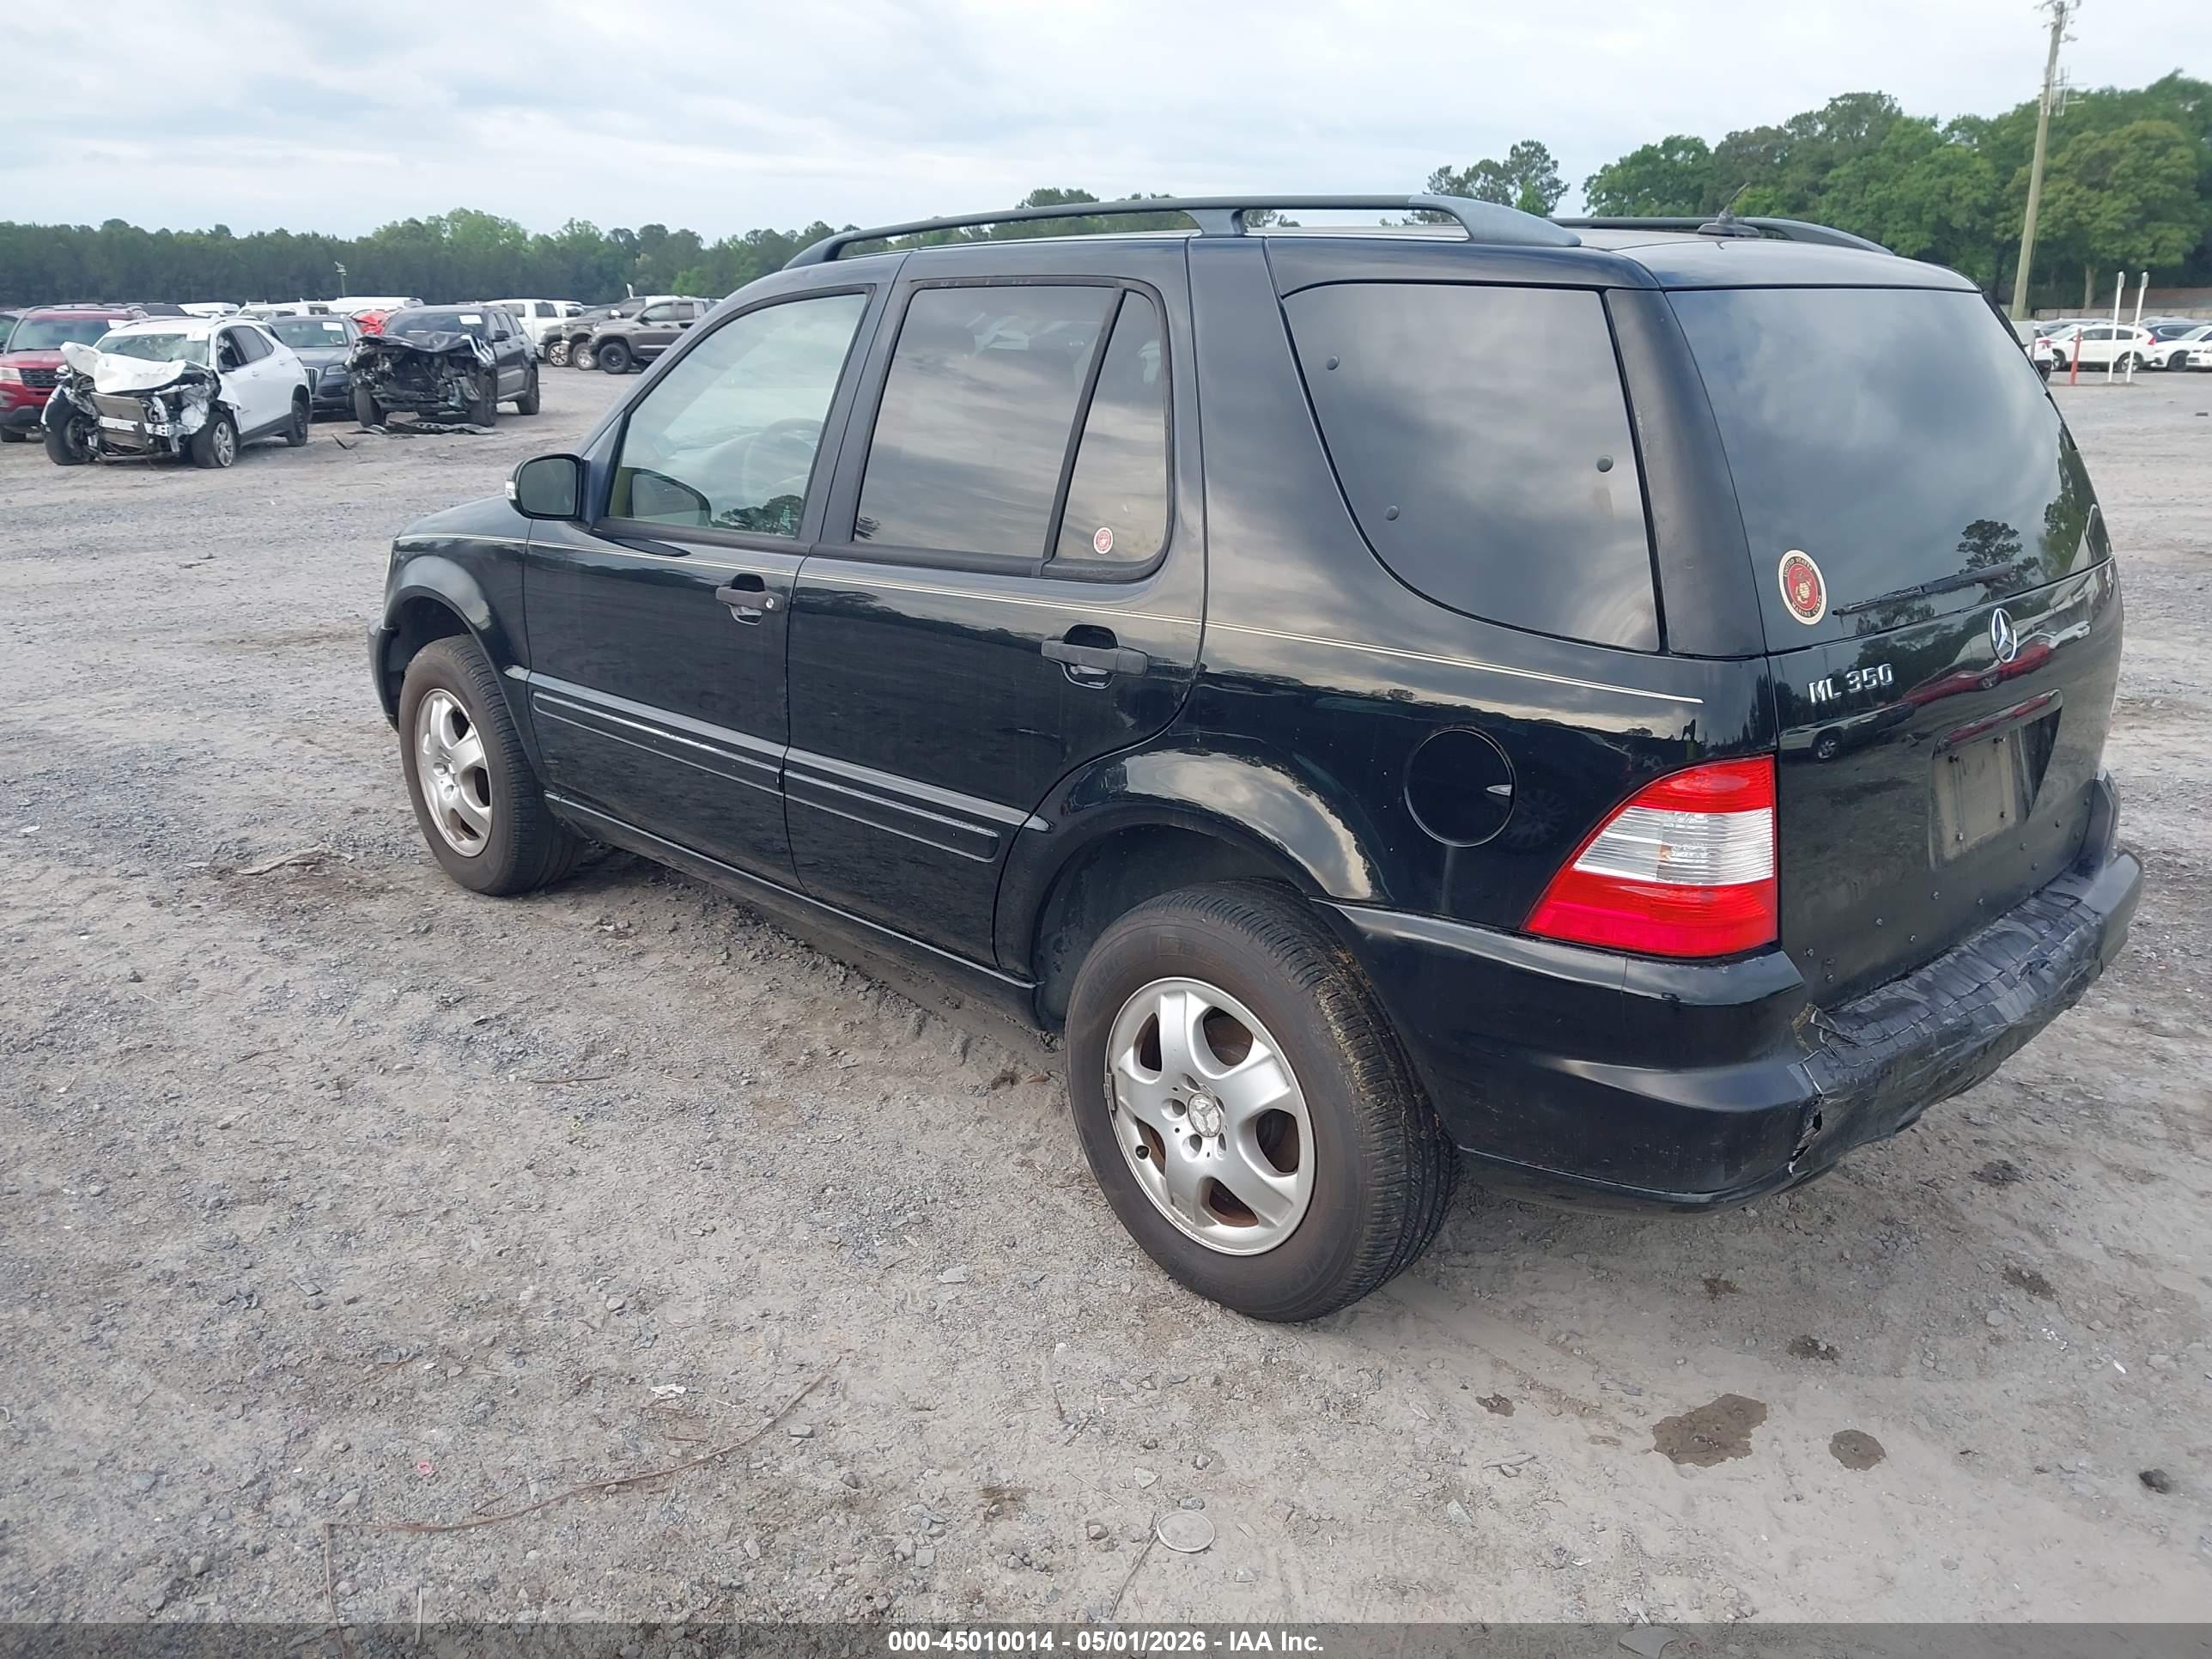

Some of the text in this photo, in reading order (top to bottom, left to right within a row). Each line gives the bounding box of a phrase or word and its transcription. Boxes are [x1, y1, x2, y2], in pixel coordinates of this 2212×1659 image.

[1791, 601, 1811, 617] MARINE
[1808, 663, 1893, 705] ML 350
